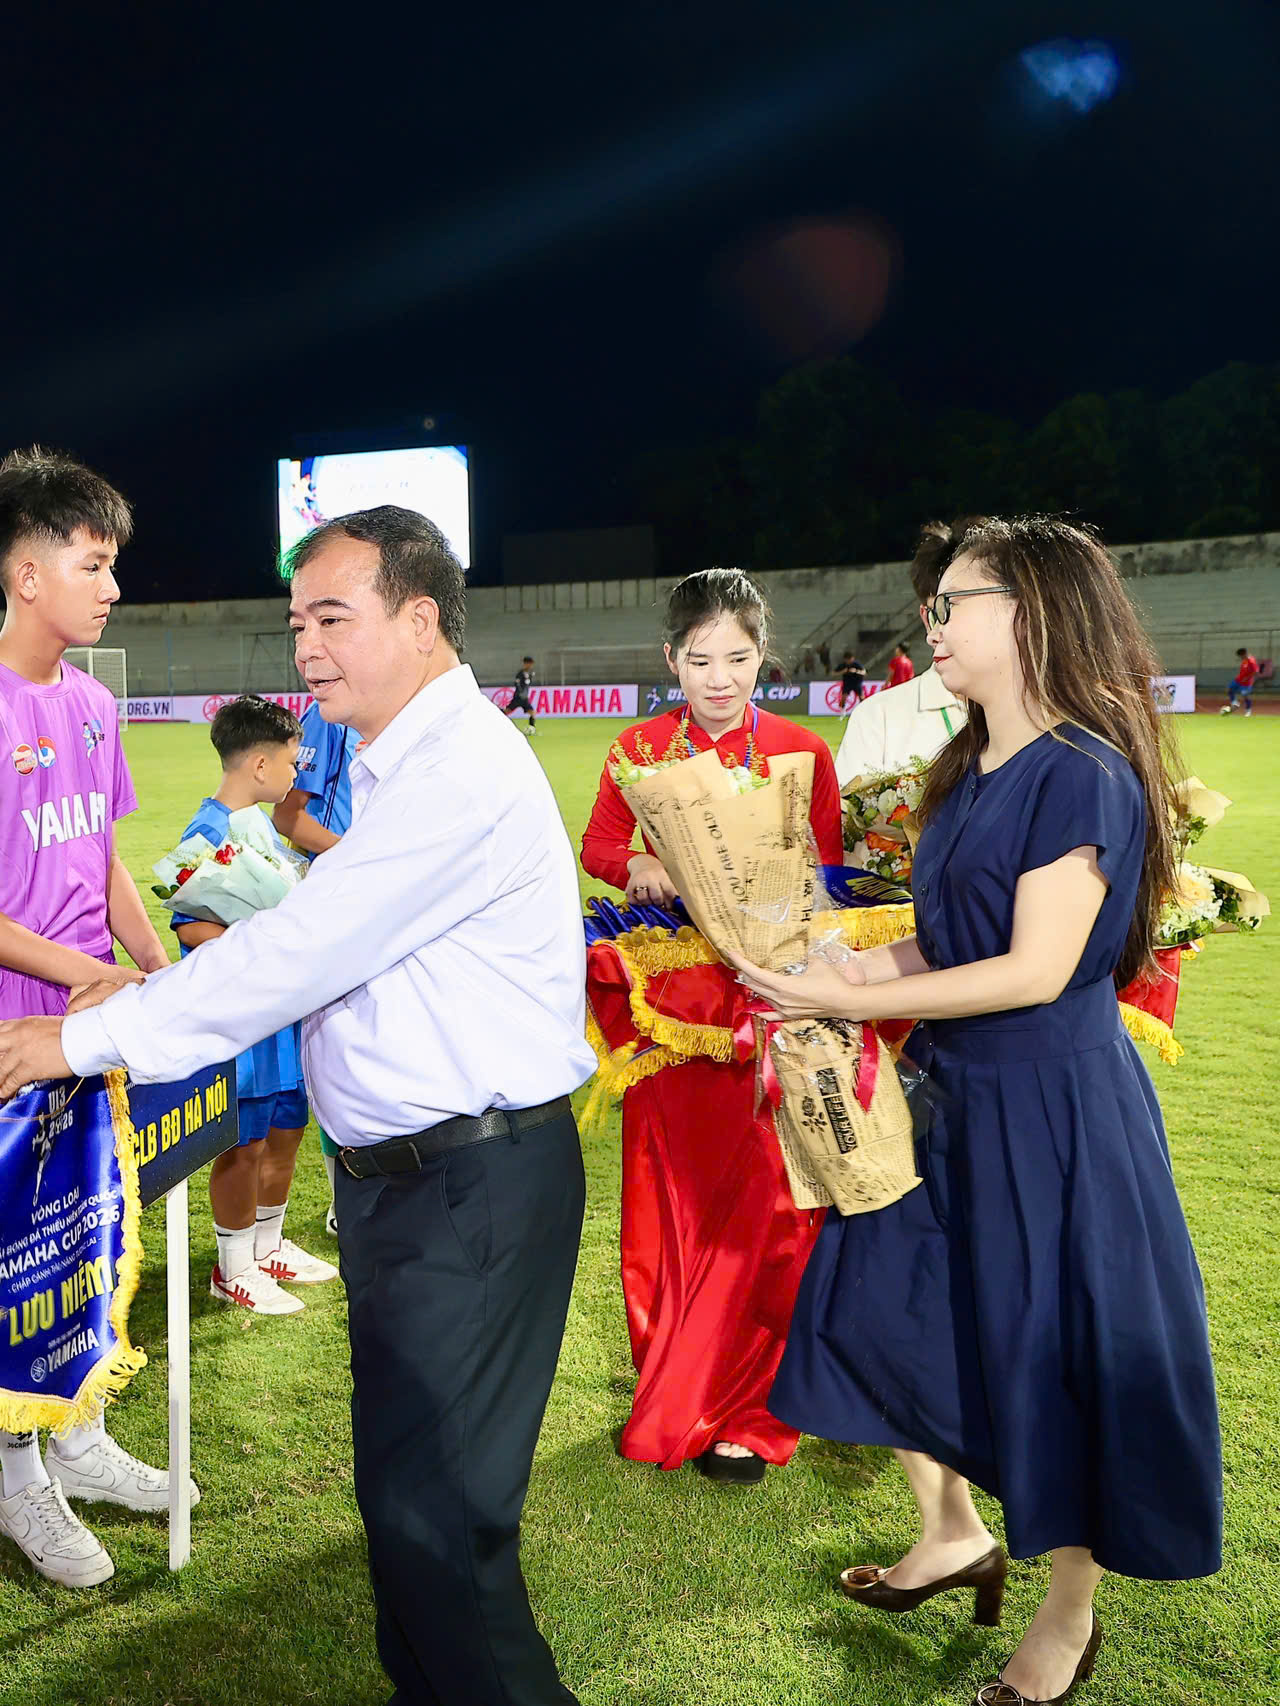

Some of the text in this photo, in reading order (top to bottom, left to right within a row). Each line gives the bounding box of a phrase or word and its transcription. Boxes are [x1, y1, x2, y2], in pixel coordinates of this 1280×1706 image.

[768, 687, 801, 701] CUP
[161, 1107, 181, 1153] BĐ
[184, 1088, 203, 1137] HÀ
[205, 1073, 228, 1123] NỘI
[31, 1200, 61, 1225] VÒNG
[61, 1221, 82, 1251] CUP
[82, 1204, 120, 1234] 2026
[9, 1288, 55, 1347] LƯU
[61, 1255, 114, 1319] NIỆM
[47, 1327, 100, 1373] YAMAHA
